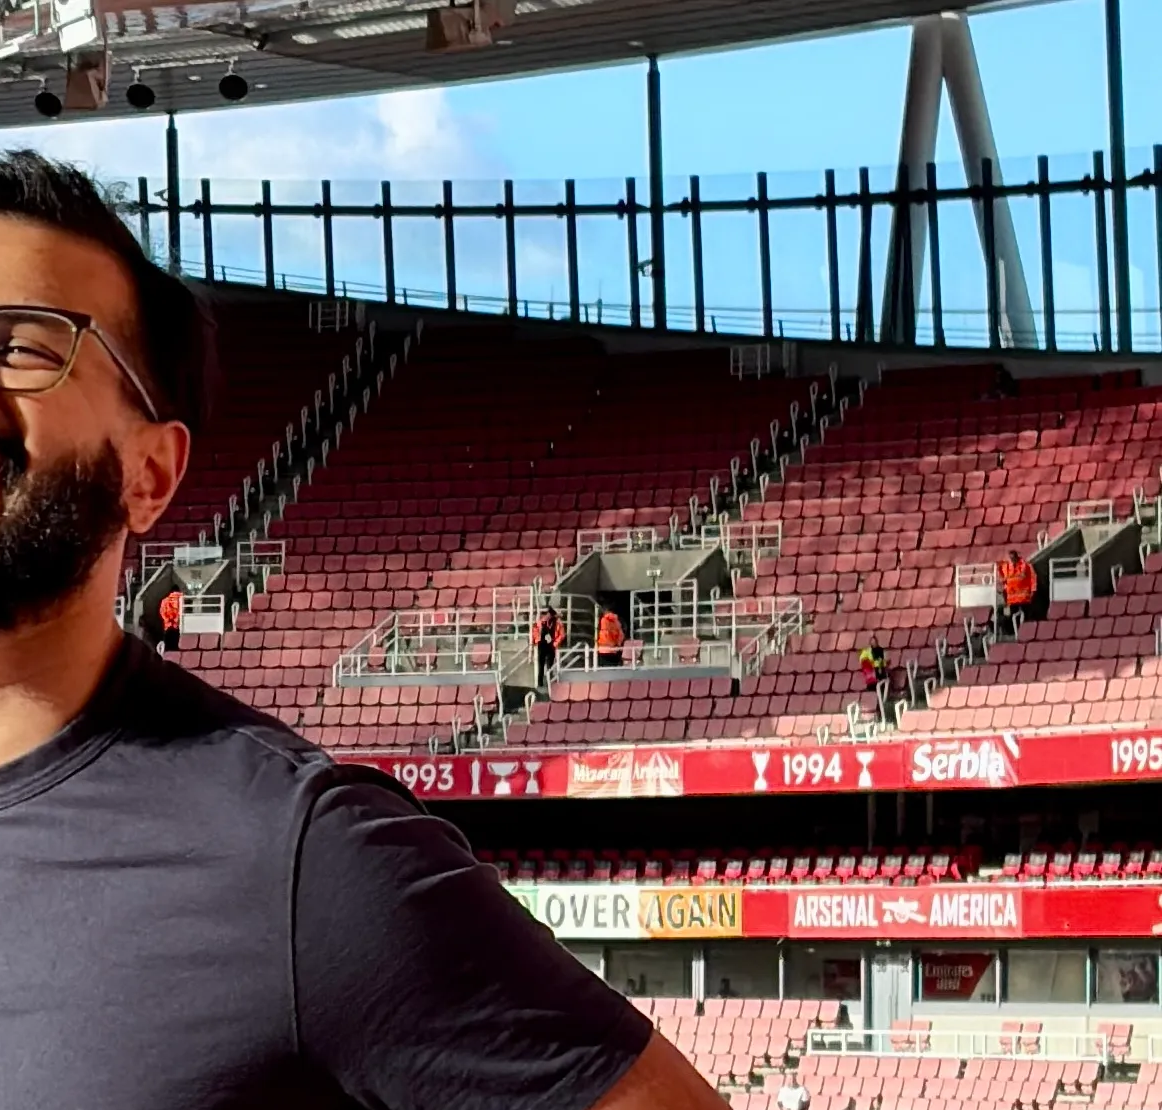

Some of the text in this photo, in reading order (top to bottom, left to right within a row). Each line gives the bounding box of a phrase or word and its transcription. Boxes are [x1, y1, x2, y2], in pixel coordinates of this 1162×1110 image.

[783, 753, 842, 785] 1994
[1111, 738, 1162, 773] 1995
[393, 763, 454, 792] 1993
[545, 892, 736, 929] OVER AGAIN
[794, 893, 1017, 928] ARSENAL AMERICA
